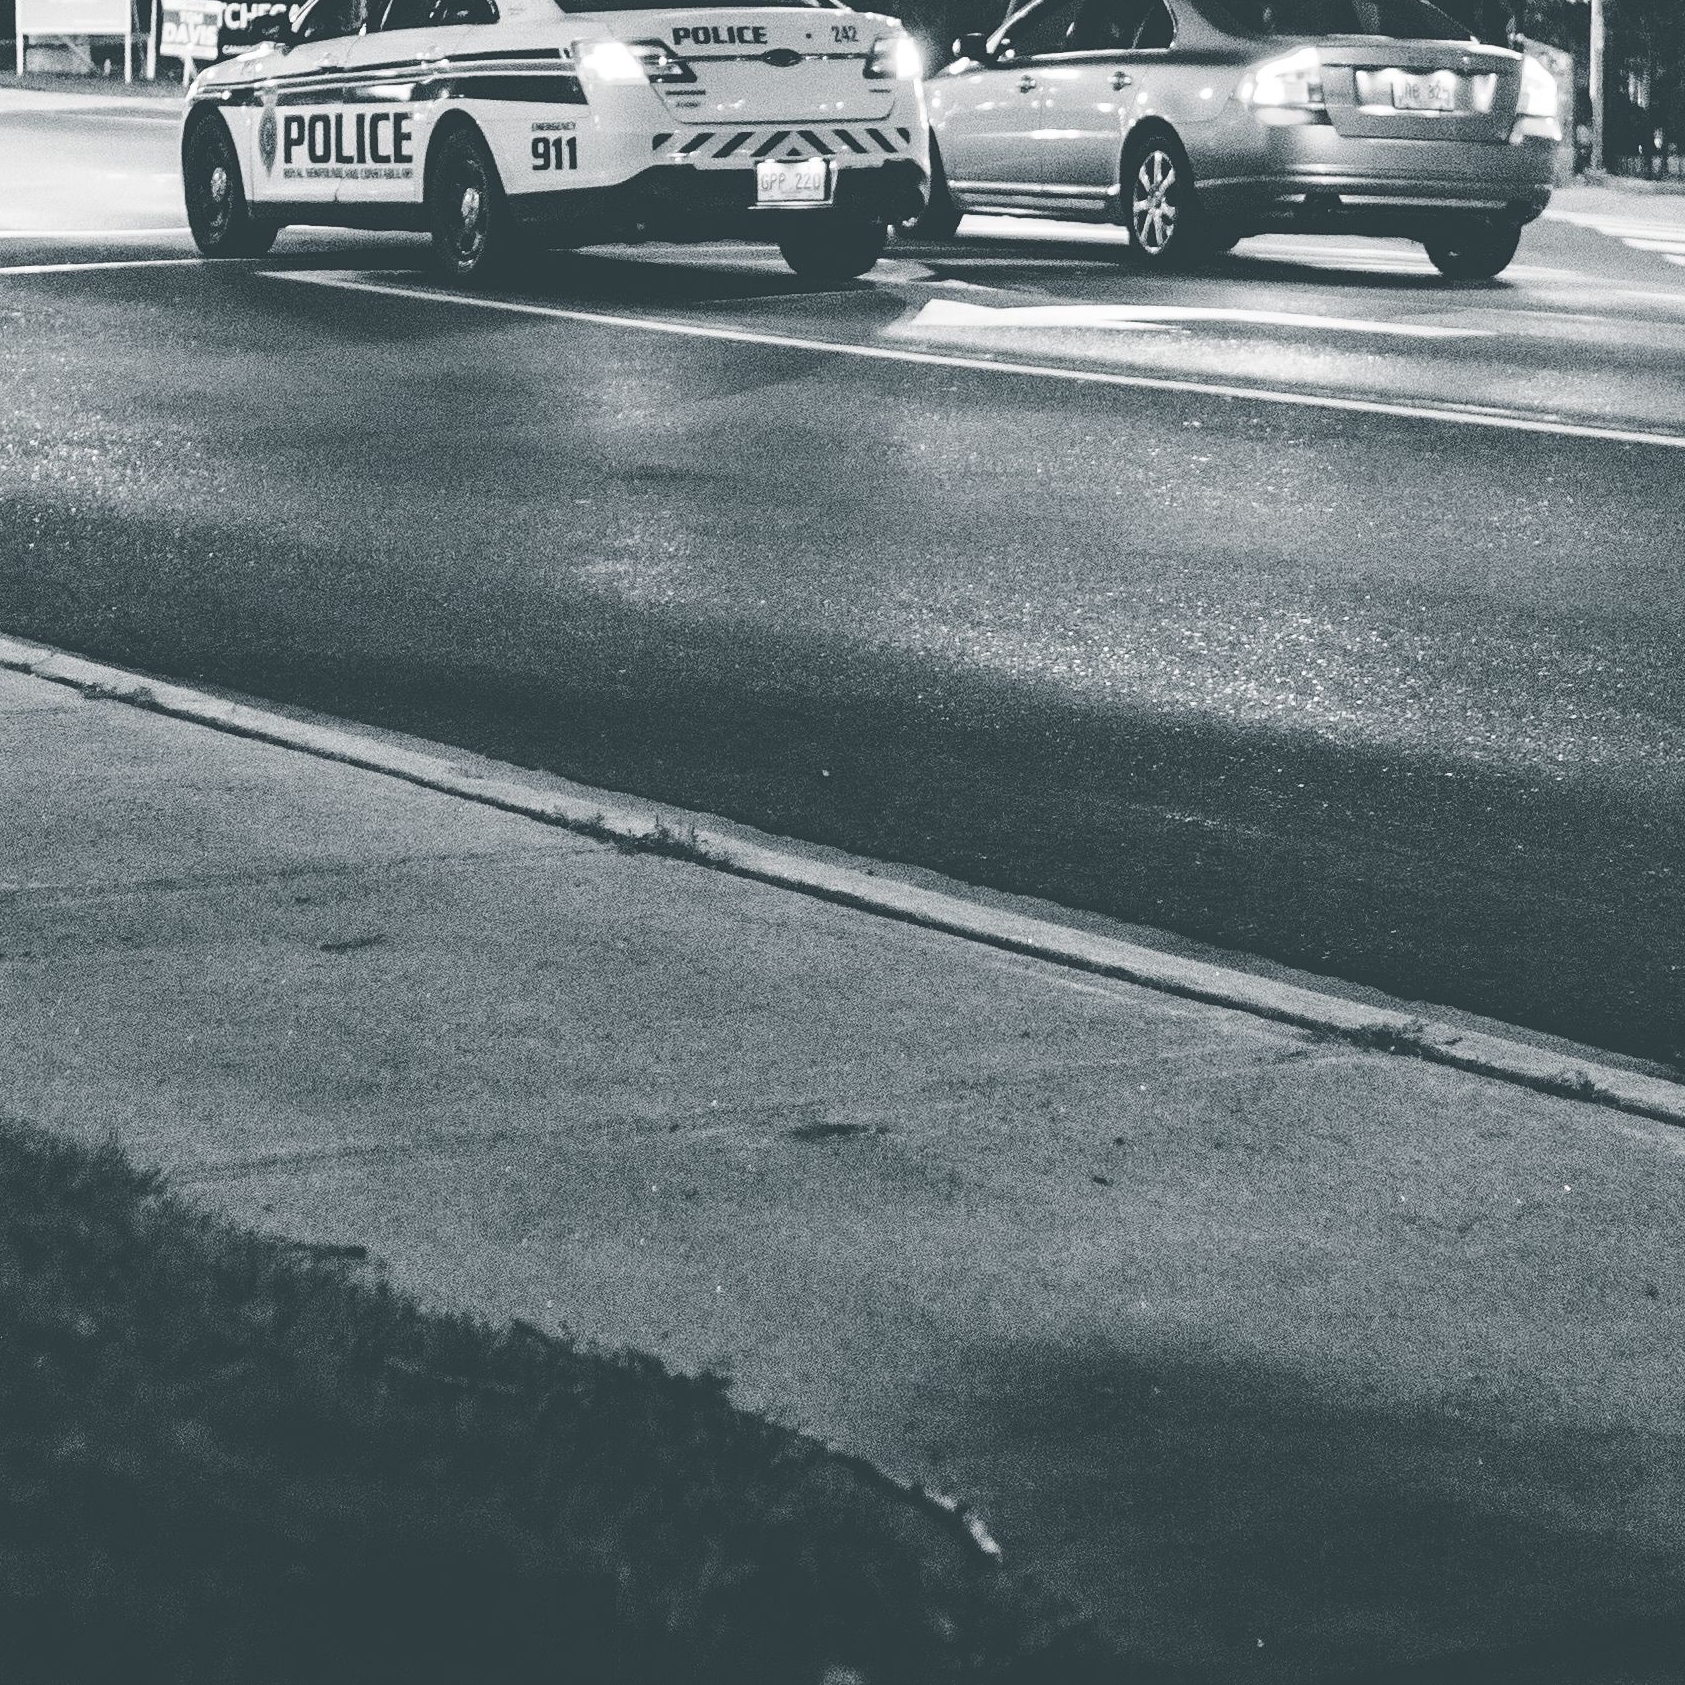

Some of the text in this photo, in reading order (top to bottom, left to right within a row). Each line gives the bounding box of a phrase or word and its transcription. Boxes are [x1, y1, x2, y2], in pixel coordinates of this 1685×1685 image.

[162, 21, 217, 46] DAVIS
[672, 26, 768, 45] POLICE
[831, 26, 860, 43] 242
[283, 112, 413, 164] POLICE
[532, 136, 577, 171] 911
[796, 173, 821, 190] 220
